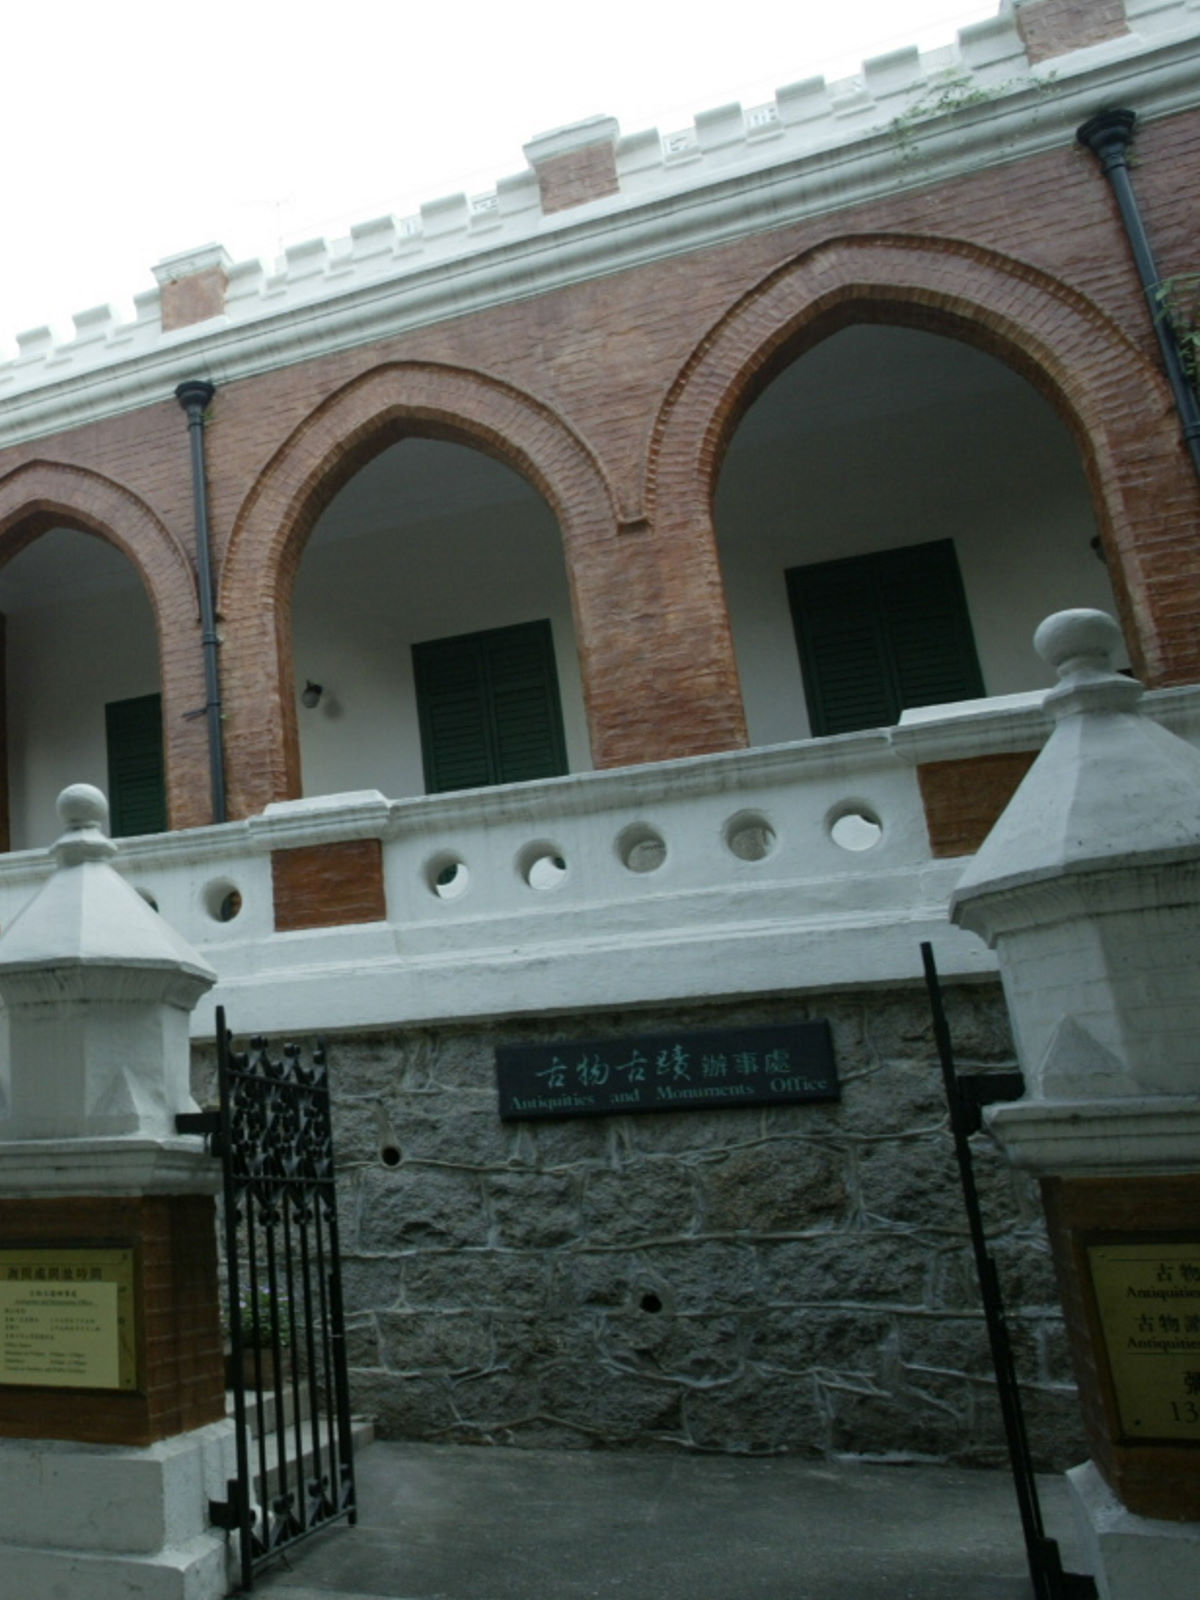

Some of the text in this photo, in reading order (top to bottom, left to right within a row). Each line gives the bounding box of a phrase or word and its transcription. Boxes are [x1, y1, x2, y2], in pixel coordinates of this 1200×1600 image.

[510, 1075, 828, 1112] Antiquities and Monuments Office
